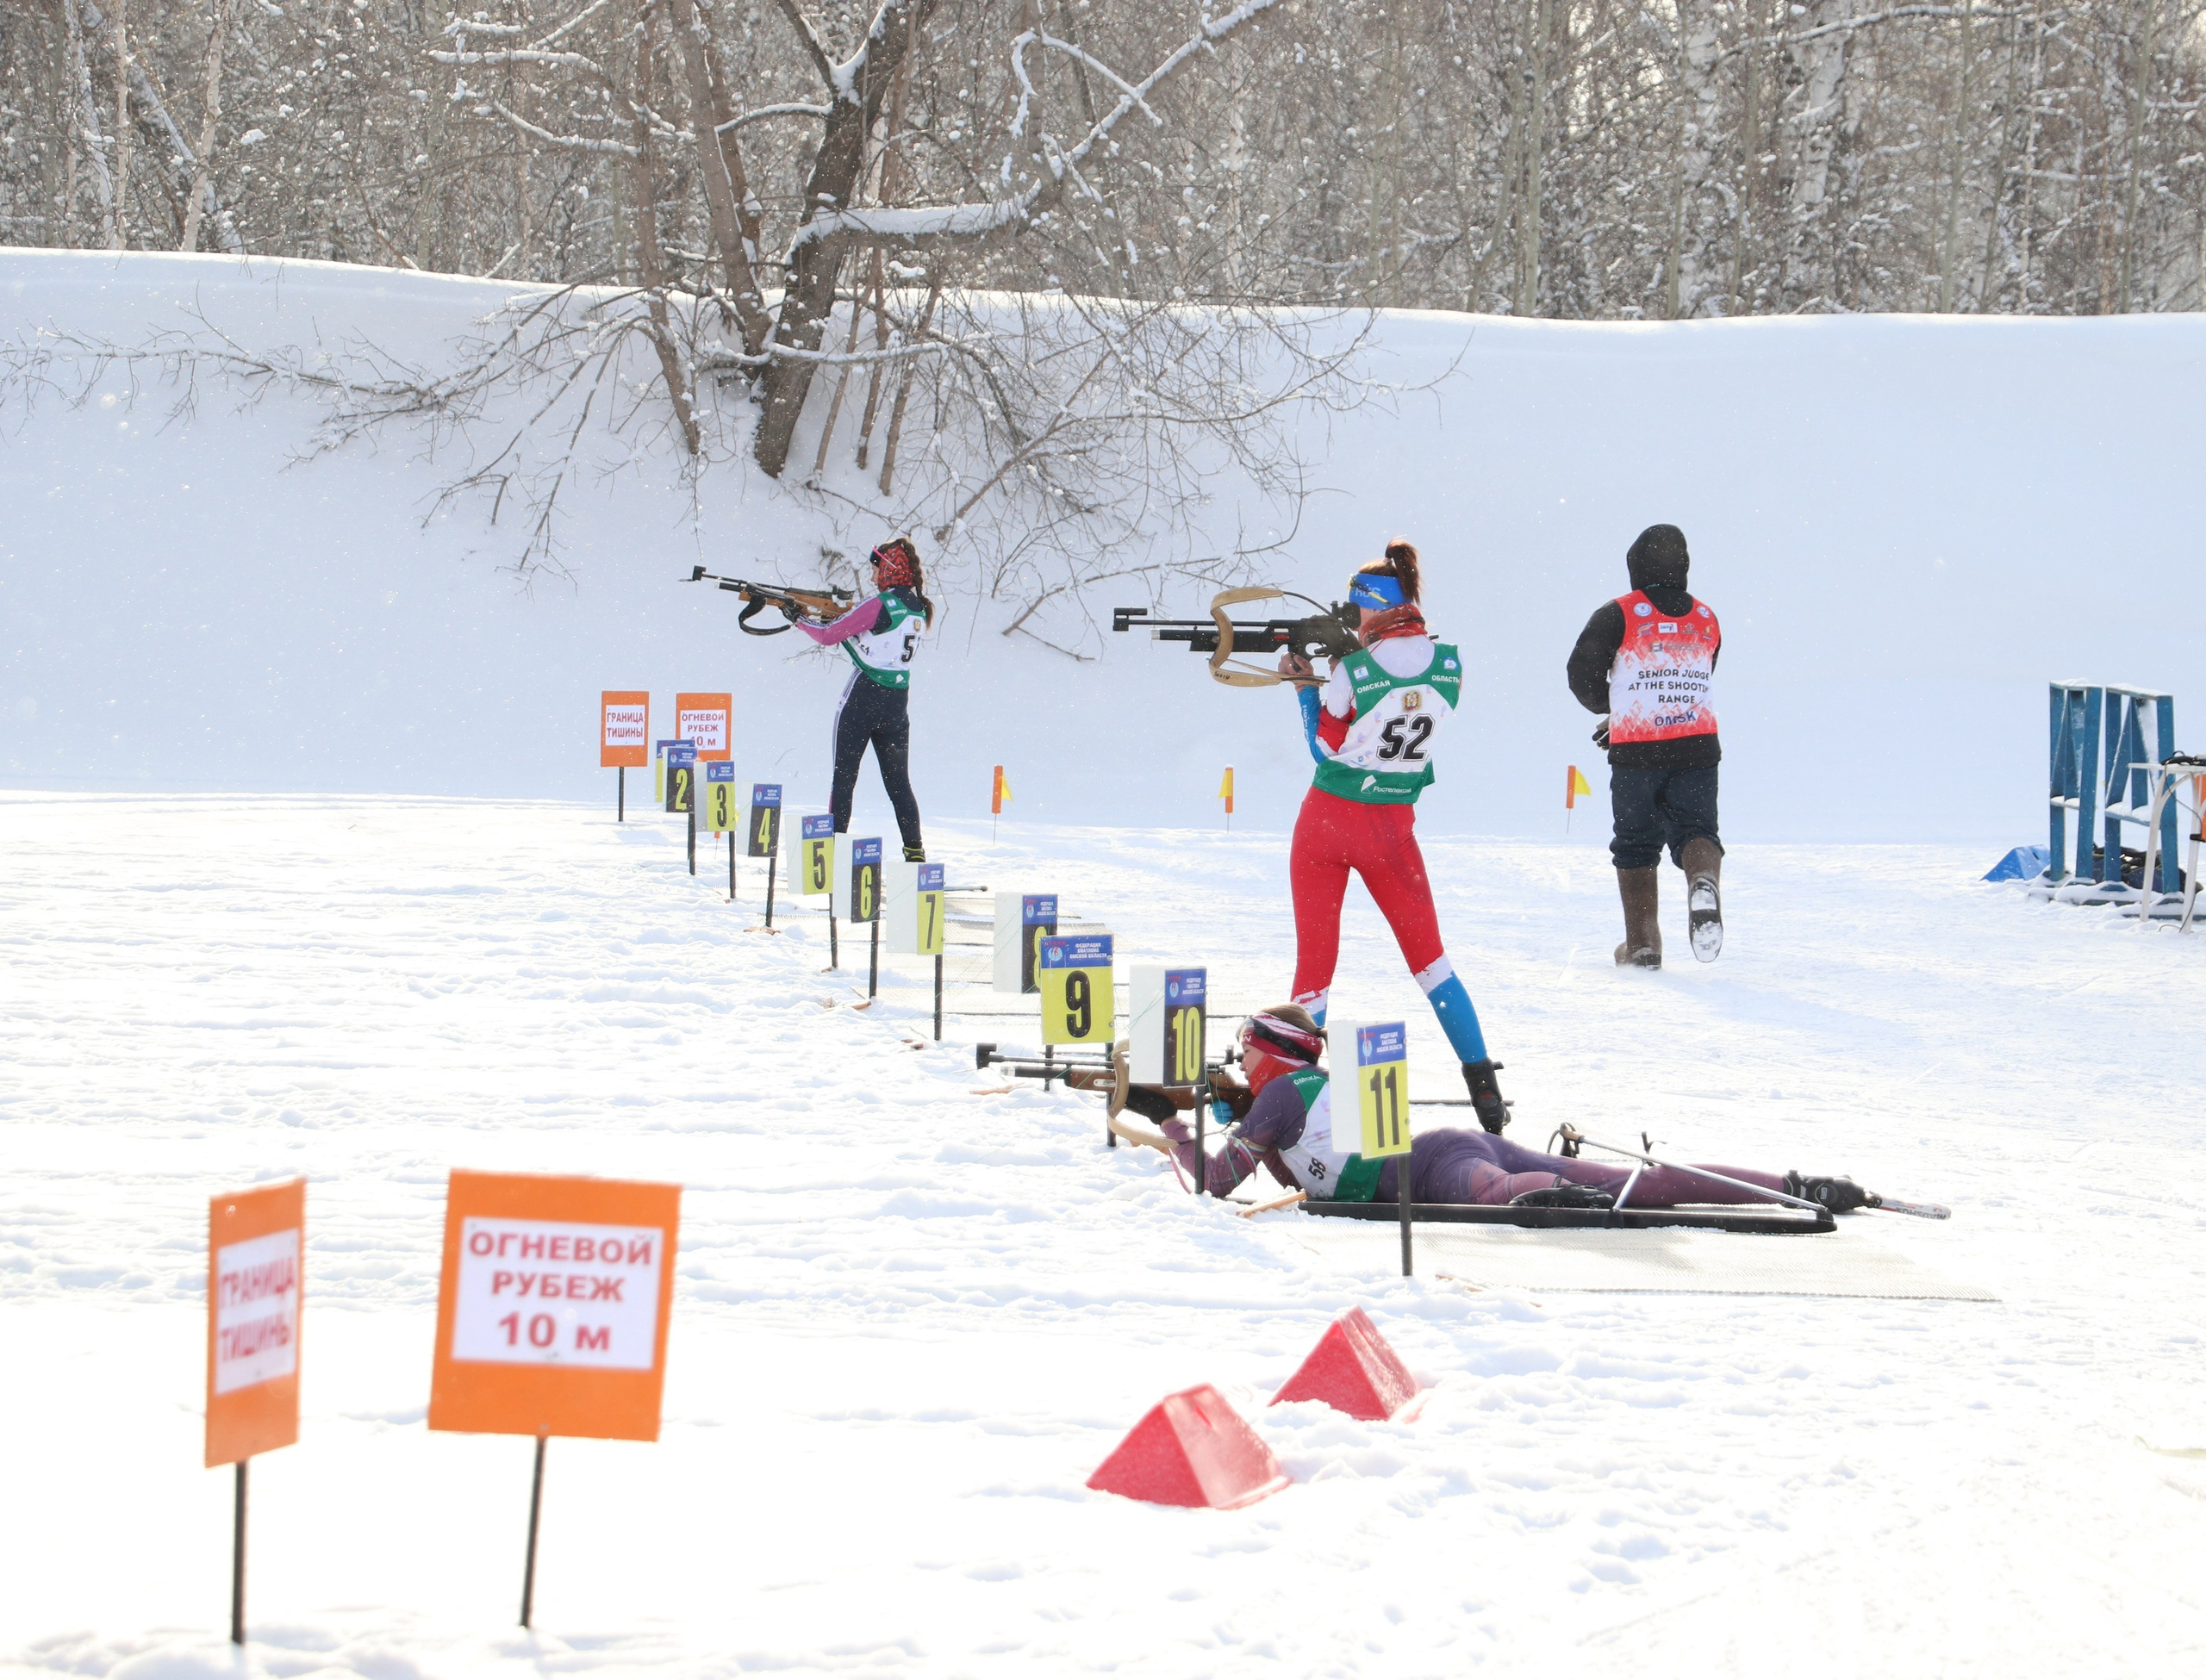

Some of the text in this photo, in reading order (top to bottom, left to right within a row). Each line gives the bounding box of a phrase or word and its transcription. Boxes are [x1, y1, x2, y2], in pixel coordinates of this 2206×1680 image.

[1356, 675, 1460, 694] ОМСКАЯ ОБЛАСТЬ
[1628, 682, 1642, 691] AT
[1644, 681, 1665, 690] THE
[1638, 669, 1710, 681] SENIOR JUDGE
[1658, 694, 1696, 704] RANGE
[607, 712, 644, 724] ГРАНИЦА
[607, 727, 643, 737] ТИШИНЫ
[687, 724, 719, 732] РУБЕЖ
[1654, 711, 1697, 726] OMSK
[1376, 714, 1434, 761] 52
[675, 768, 689, 810] 2
[717, 784, 726, 827] 3
[757, 808, 771, 853] 4
[813, 841, 826, 890] 5
[861, 865, 872, 918] 6
[925, 893, 937, 949] 7
[1065, 970, 1092, 1038] 9
[1172, 1006, 1201, 1081] 10
[1369, 1066, 1400, 1148] 11
[1307, 1157, 1327, 1180] 58
[469, 1229, 652, 1266] ОГНЕВОЙ
[492, 1271, 626, 1303] РУБЕЖ
[498, 1312, 556, 1348] 10
